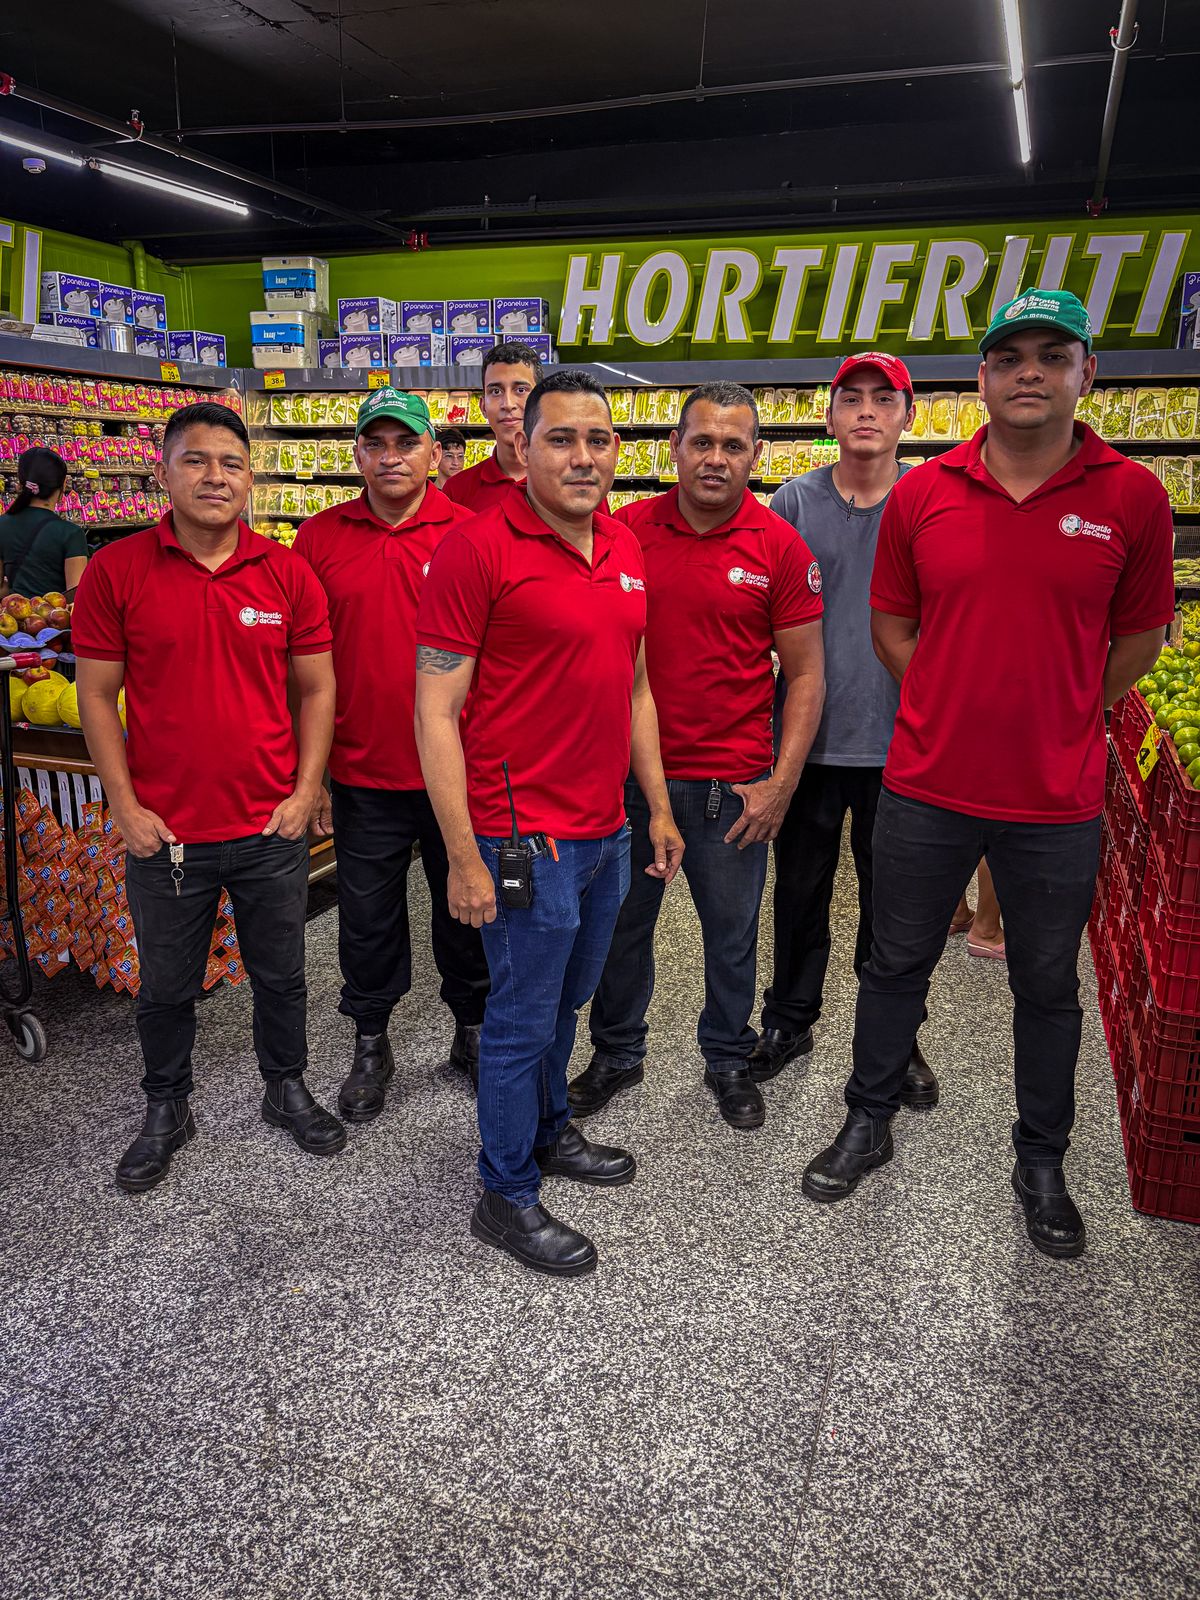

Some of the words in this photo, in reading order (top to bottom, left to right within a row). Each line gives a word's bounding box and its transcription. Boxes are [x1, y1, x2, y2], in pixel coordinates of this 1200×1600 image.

[346, 300, 369, 308] panelux
[409, 303, 434, 311] panelux
[454, 301, 479, 309] panelux
[503, 299, 529, 308] panelux
[62, 317, 87, 326] panelux
[347, 335, 372, 343] panelux
[396, 334, 421, 343] panelux
[459, 336, 485, 345] panelux
[1083, 521, 1112, 535] Baratão
[1081, 528, 1091, 536] da
[1091, 529, 1111, 541] Carne
[745, 571, 770, 583] Baratão
[753, 579, 769, 589] Carne
[259, 611, 282, 619] Baratão
